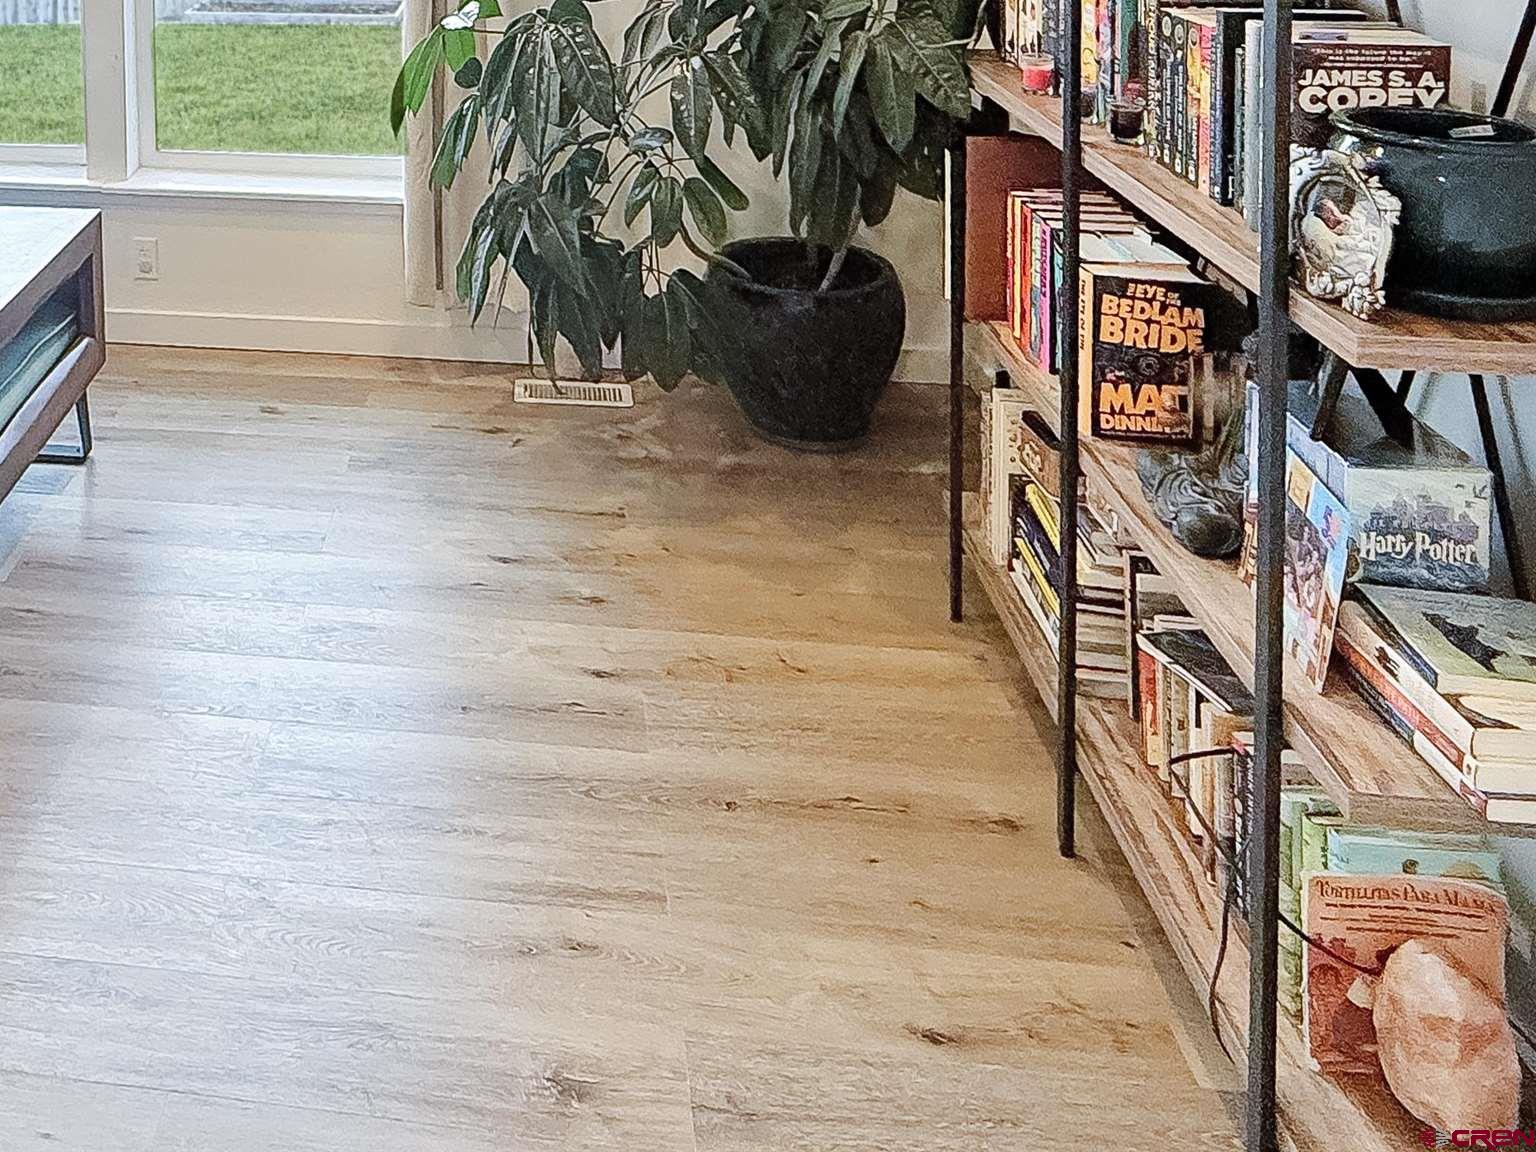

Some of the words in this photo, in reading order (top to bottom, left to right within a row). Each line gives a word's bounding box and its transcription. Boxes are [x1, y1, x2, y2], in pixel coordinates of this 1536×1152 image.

[1297, 68, 1384, 87] JAMES
[1387, 69, 1413, 88] S.
[1416, 70, 1446, 88] A.
[1298, 85, 1446, 114] COREY
[1135, 283, 1166, 302] EYE
[1101, 293, 1205, 329] BEDLAM
[1099, 314, 1205, 353] BRIDE
[1358, 530, 1414, 561] Harry
[1414, 530, 1478, 565] Potter
